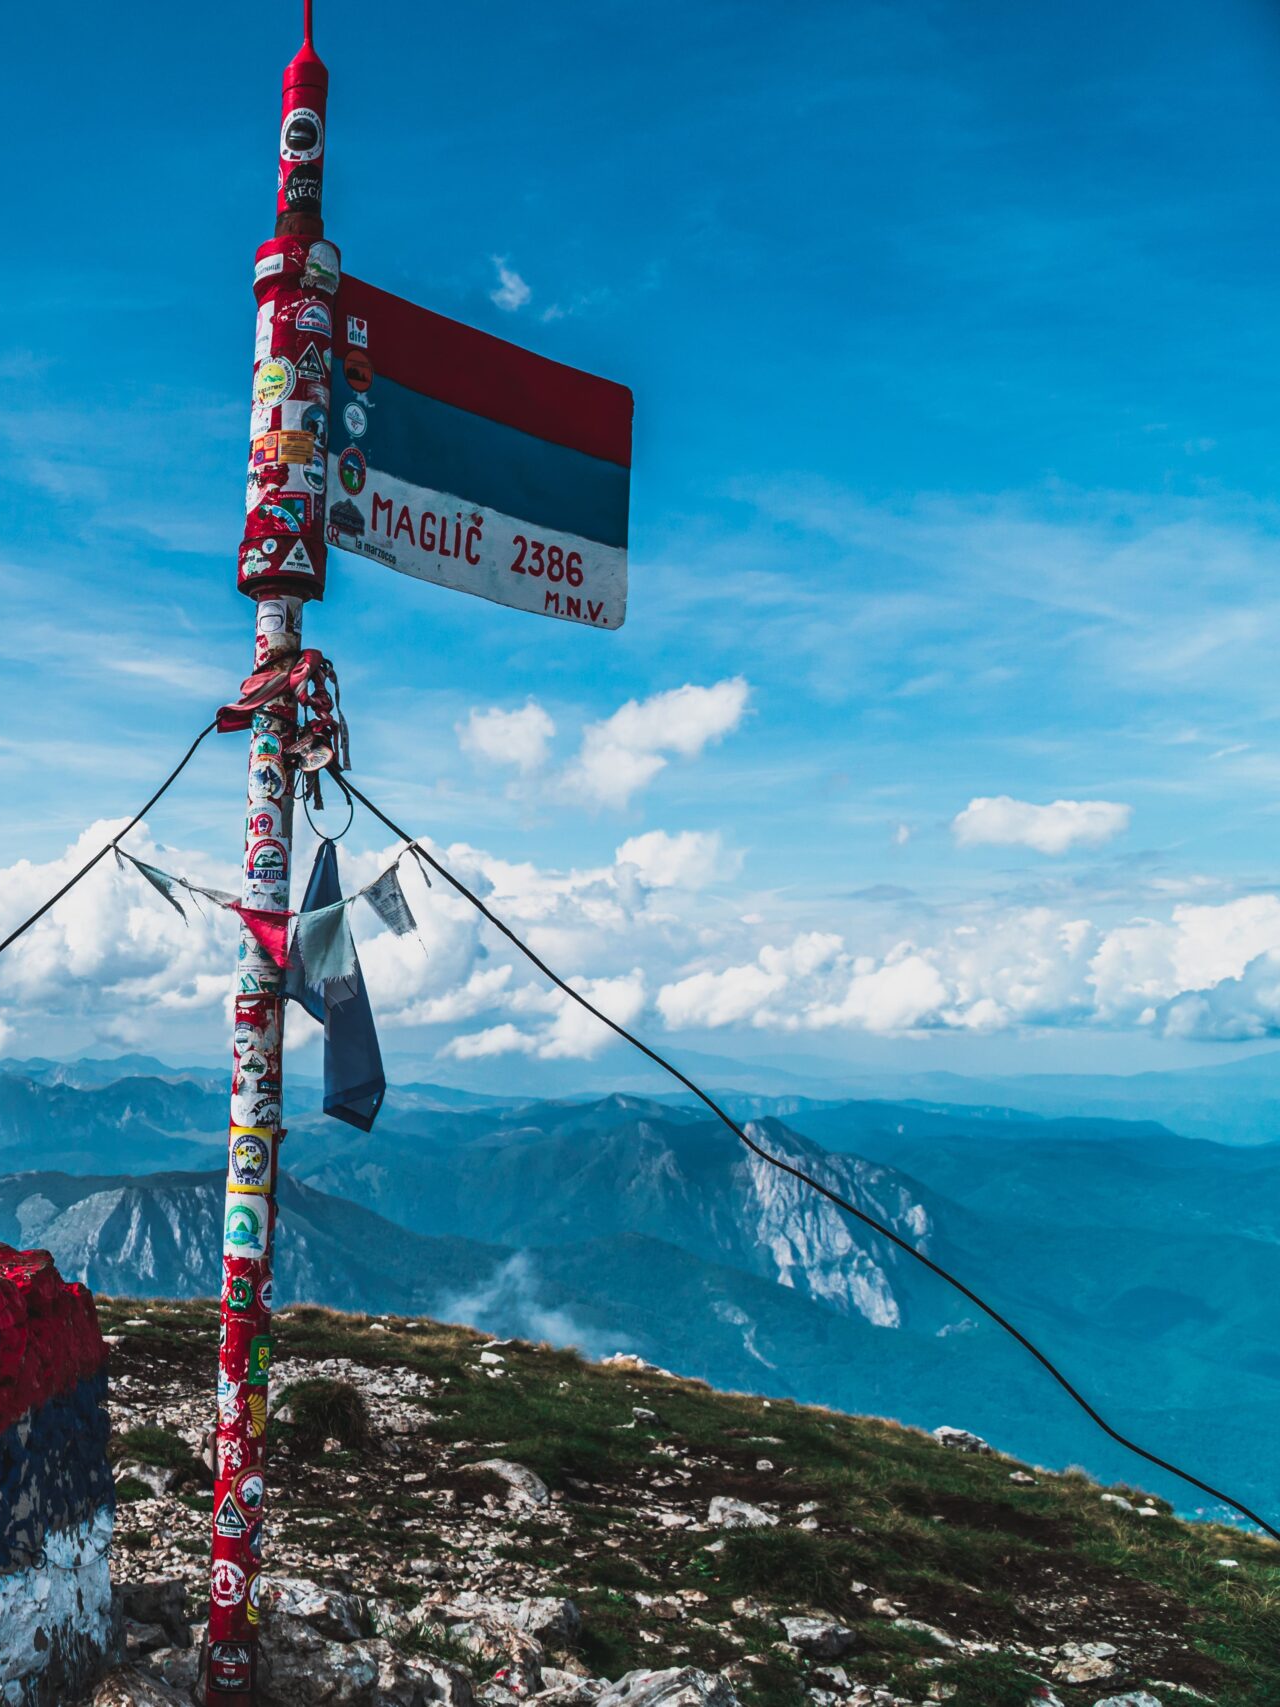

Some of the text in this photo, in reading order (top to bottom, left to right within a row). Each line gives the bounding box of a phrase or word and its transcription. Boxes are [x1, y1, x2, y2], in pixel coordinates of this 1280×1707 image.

[293, 111, 315, 119] BALKAN
[355, 537, 397, 565] la marzocco
[510, 535, 584, 587] 2386
[544, 590, 608, 624] M.N.V.
